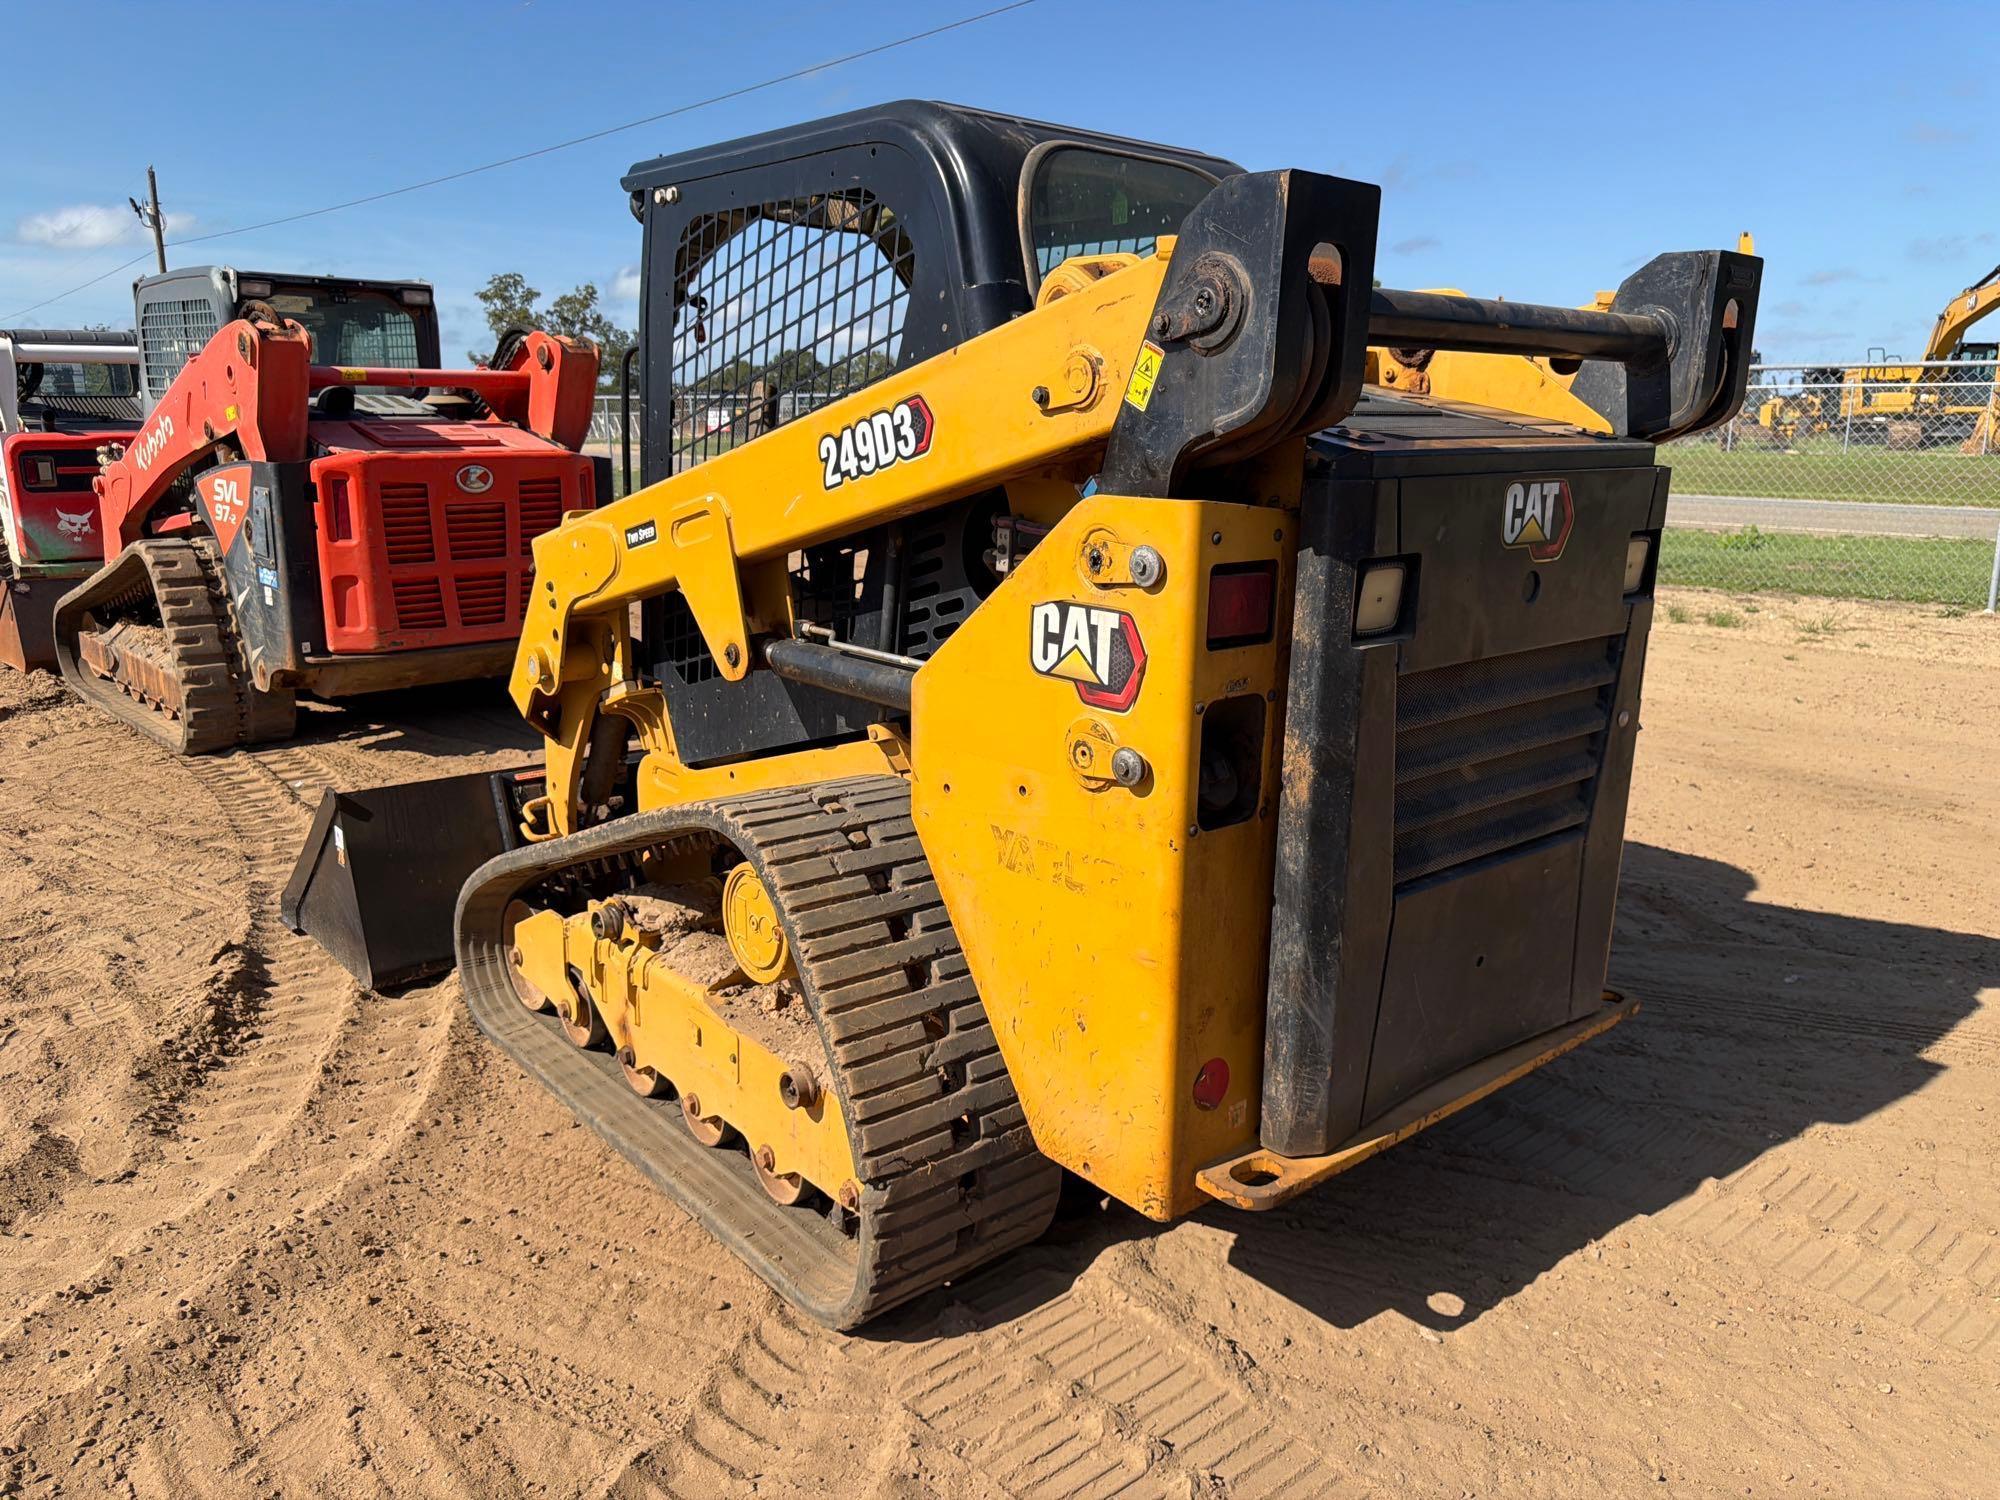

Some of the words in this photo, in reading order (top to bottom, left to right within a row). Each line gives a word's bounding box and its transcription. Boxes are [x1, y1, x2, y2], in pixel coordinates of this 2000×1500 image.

[134, 414, 175, 471] Kubota
[819, 403, 917, 488] 249D3
[213, 477, 244, 507] SVL
[1503, 482, 1560, 544] CAT
[1031, 602, 1120, 686] CAT
